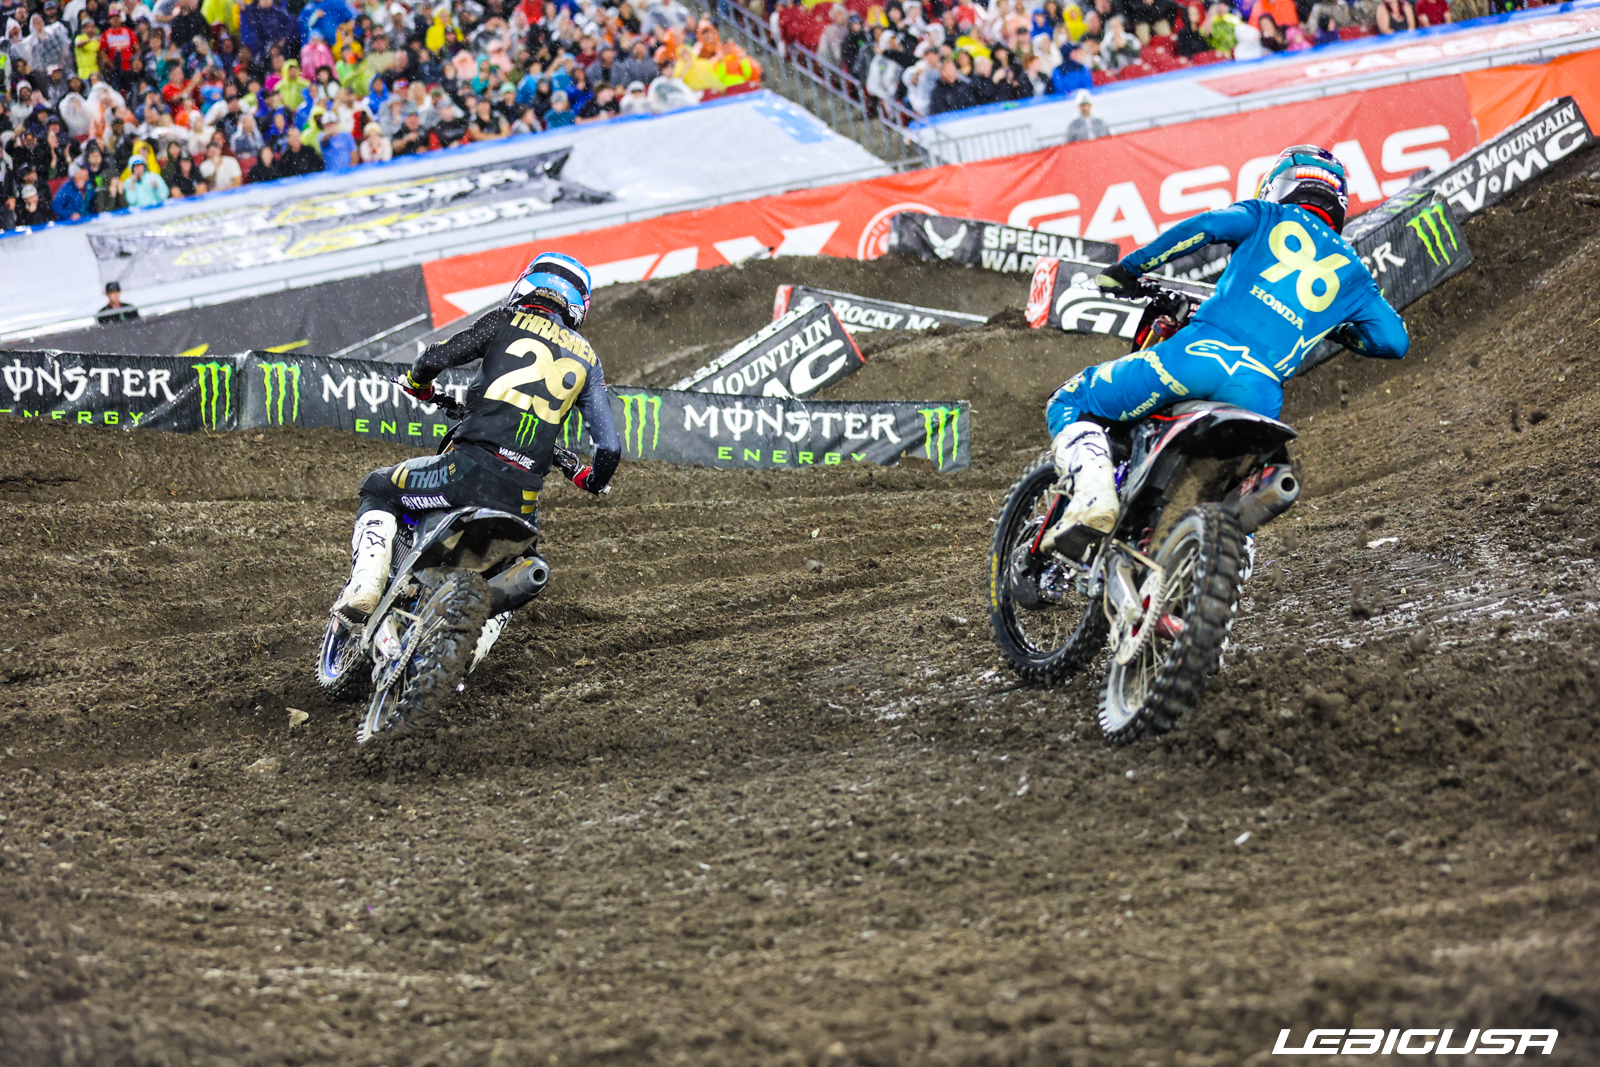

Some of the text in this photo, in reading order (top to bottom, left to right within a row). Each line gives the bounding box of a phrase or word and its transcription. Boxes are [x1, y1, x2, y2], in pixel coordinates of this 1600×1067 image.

[1476, 102, 1576, 176] MOUNTAIN
[983, 225, 1090, 263] SPECIAL
[1259, 220, 1351, 313] 96
[833, 299, 904, 331] ROCKY
[1249, 284, 1304, 331] HONDA
[510, 311, 597, 368] THRASHER
[483, 337, 588, 425] 29
[684, 402, 901, 443] MONSTER
[409, 465, 449, 489] THOR
[499, 446, 535, 470] YAMALUBE
